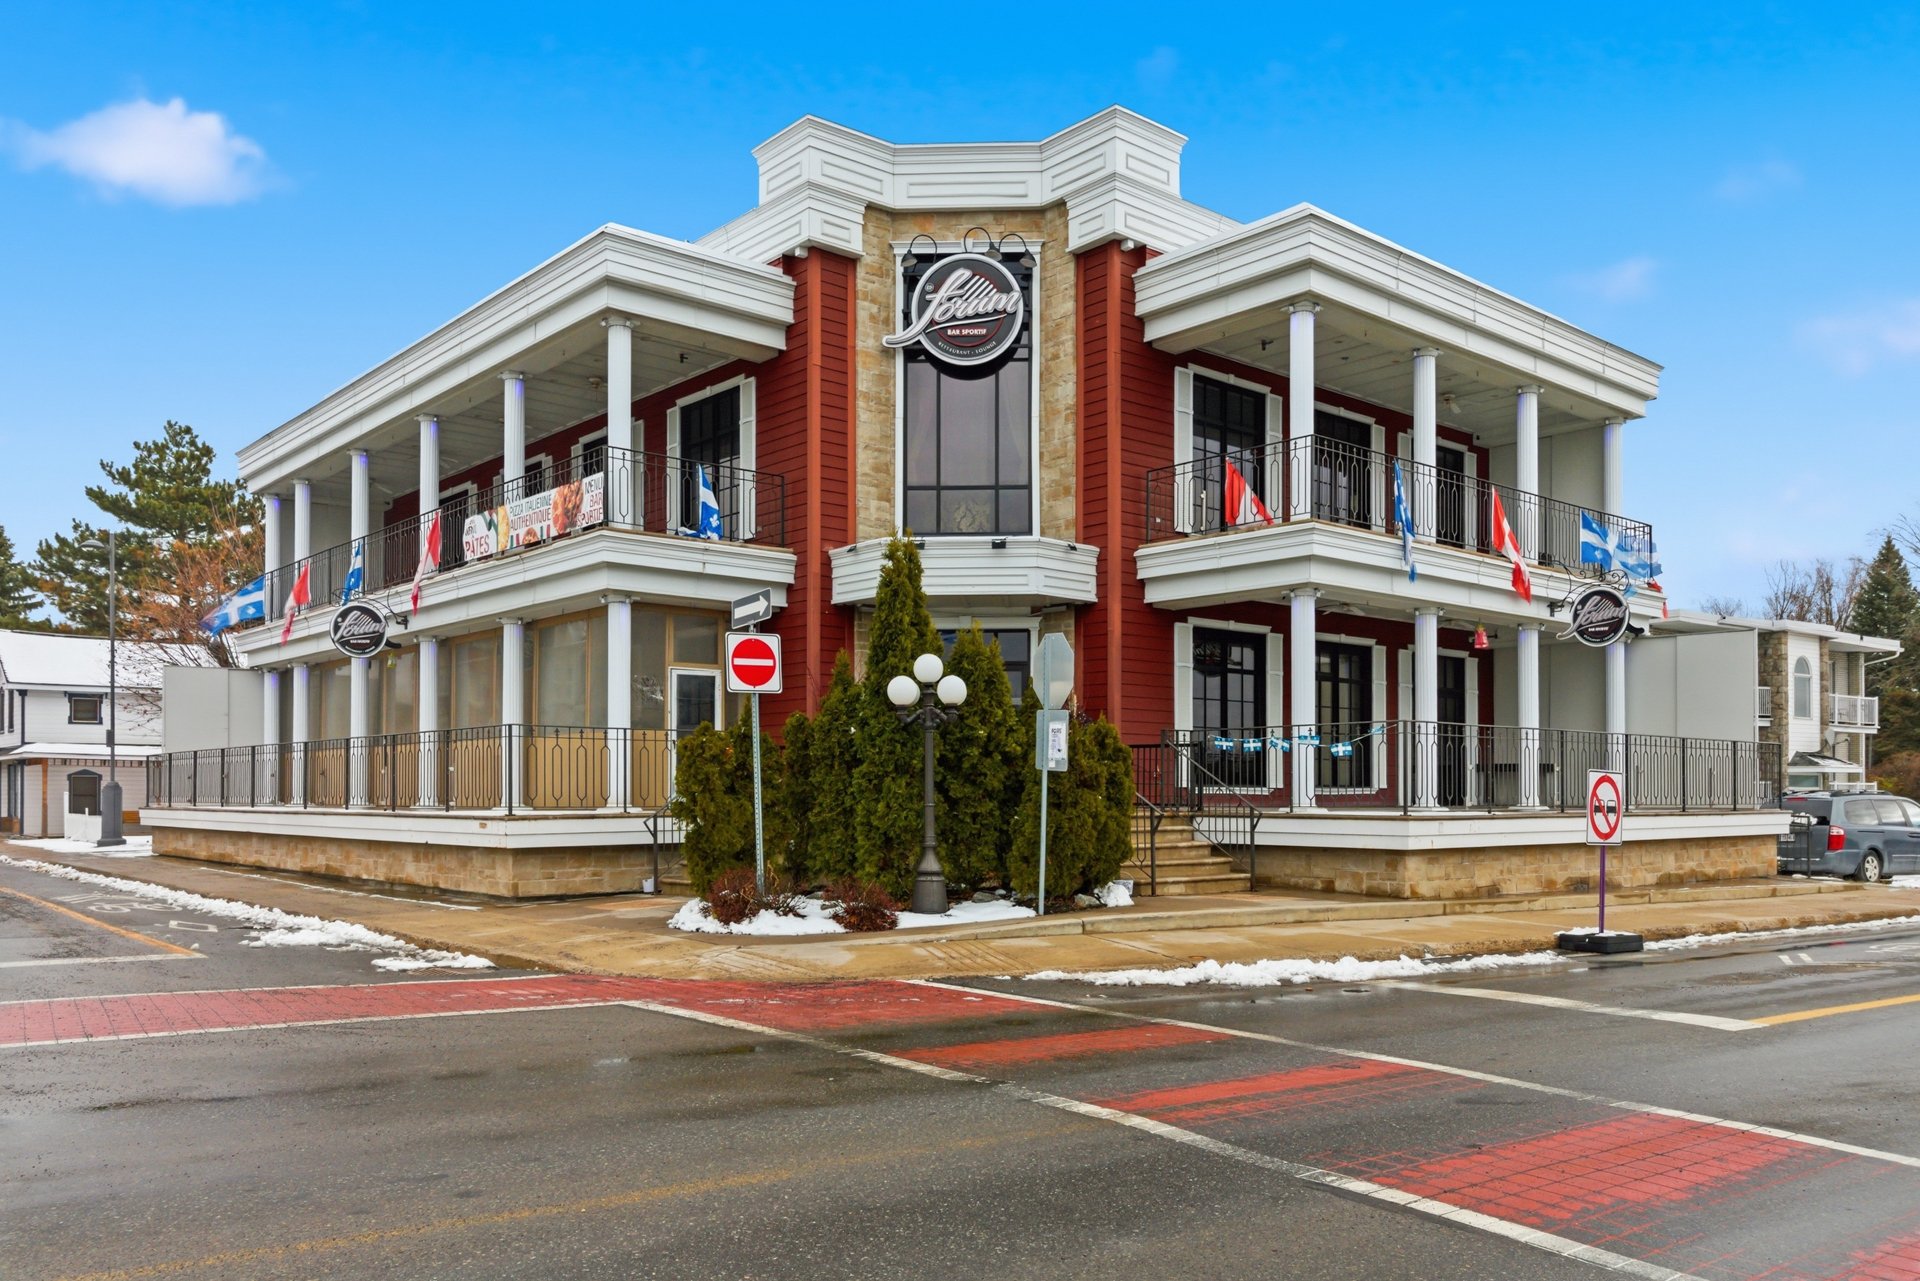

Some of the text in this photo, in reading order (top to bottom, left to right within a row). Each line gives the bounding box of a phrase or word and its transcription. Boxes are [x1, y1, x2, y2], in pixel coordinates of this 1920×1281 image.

[947, 328, 987, 336] BAR SPORTIF
[584, 476, 603, 495] MENU
[510, 494, 552, 517] PIZZA ITALIENNE
[589, 492, 603, 508] BAR
[510, 508, 551, 531] AUTHENTIQUE
[465, 535, 490, 559] PÂTES
